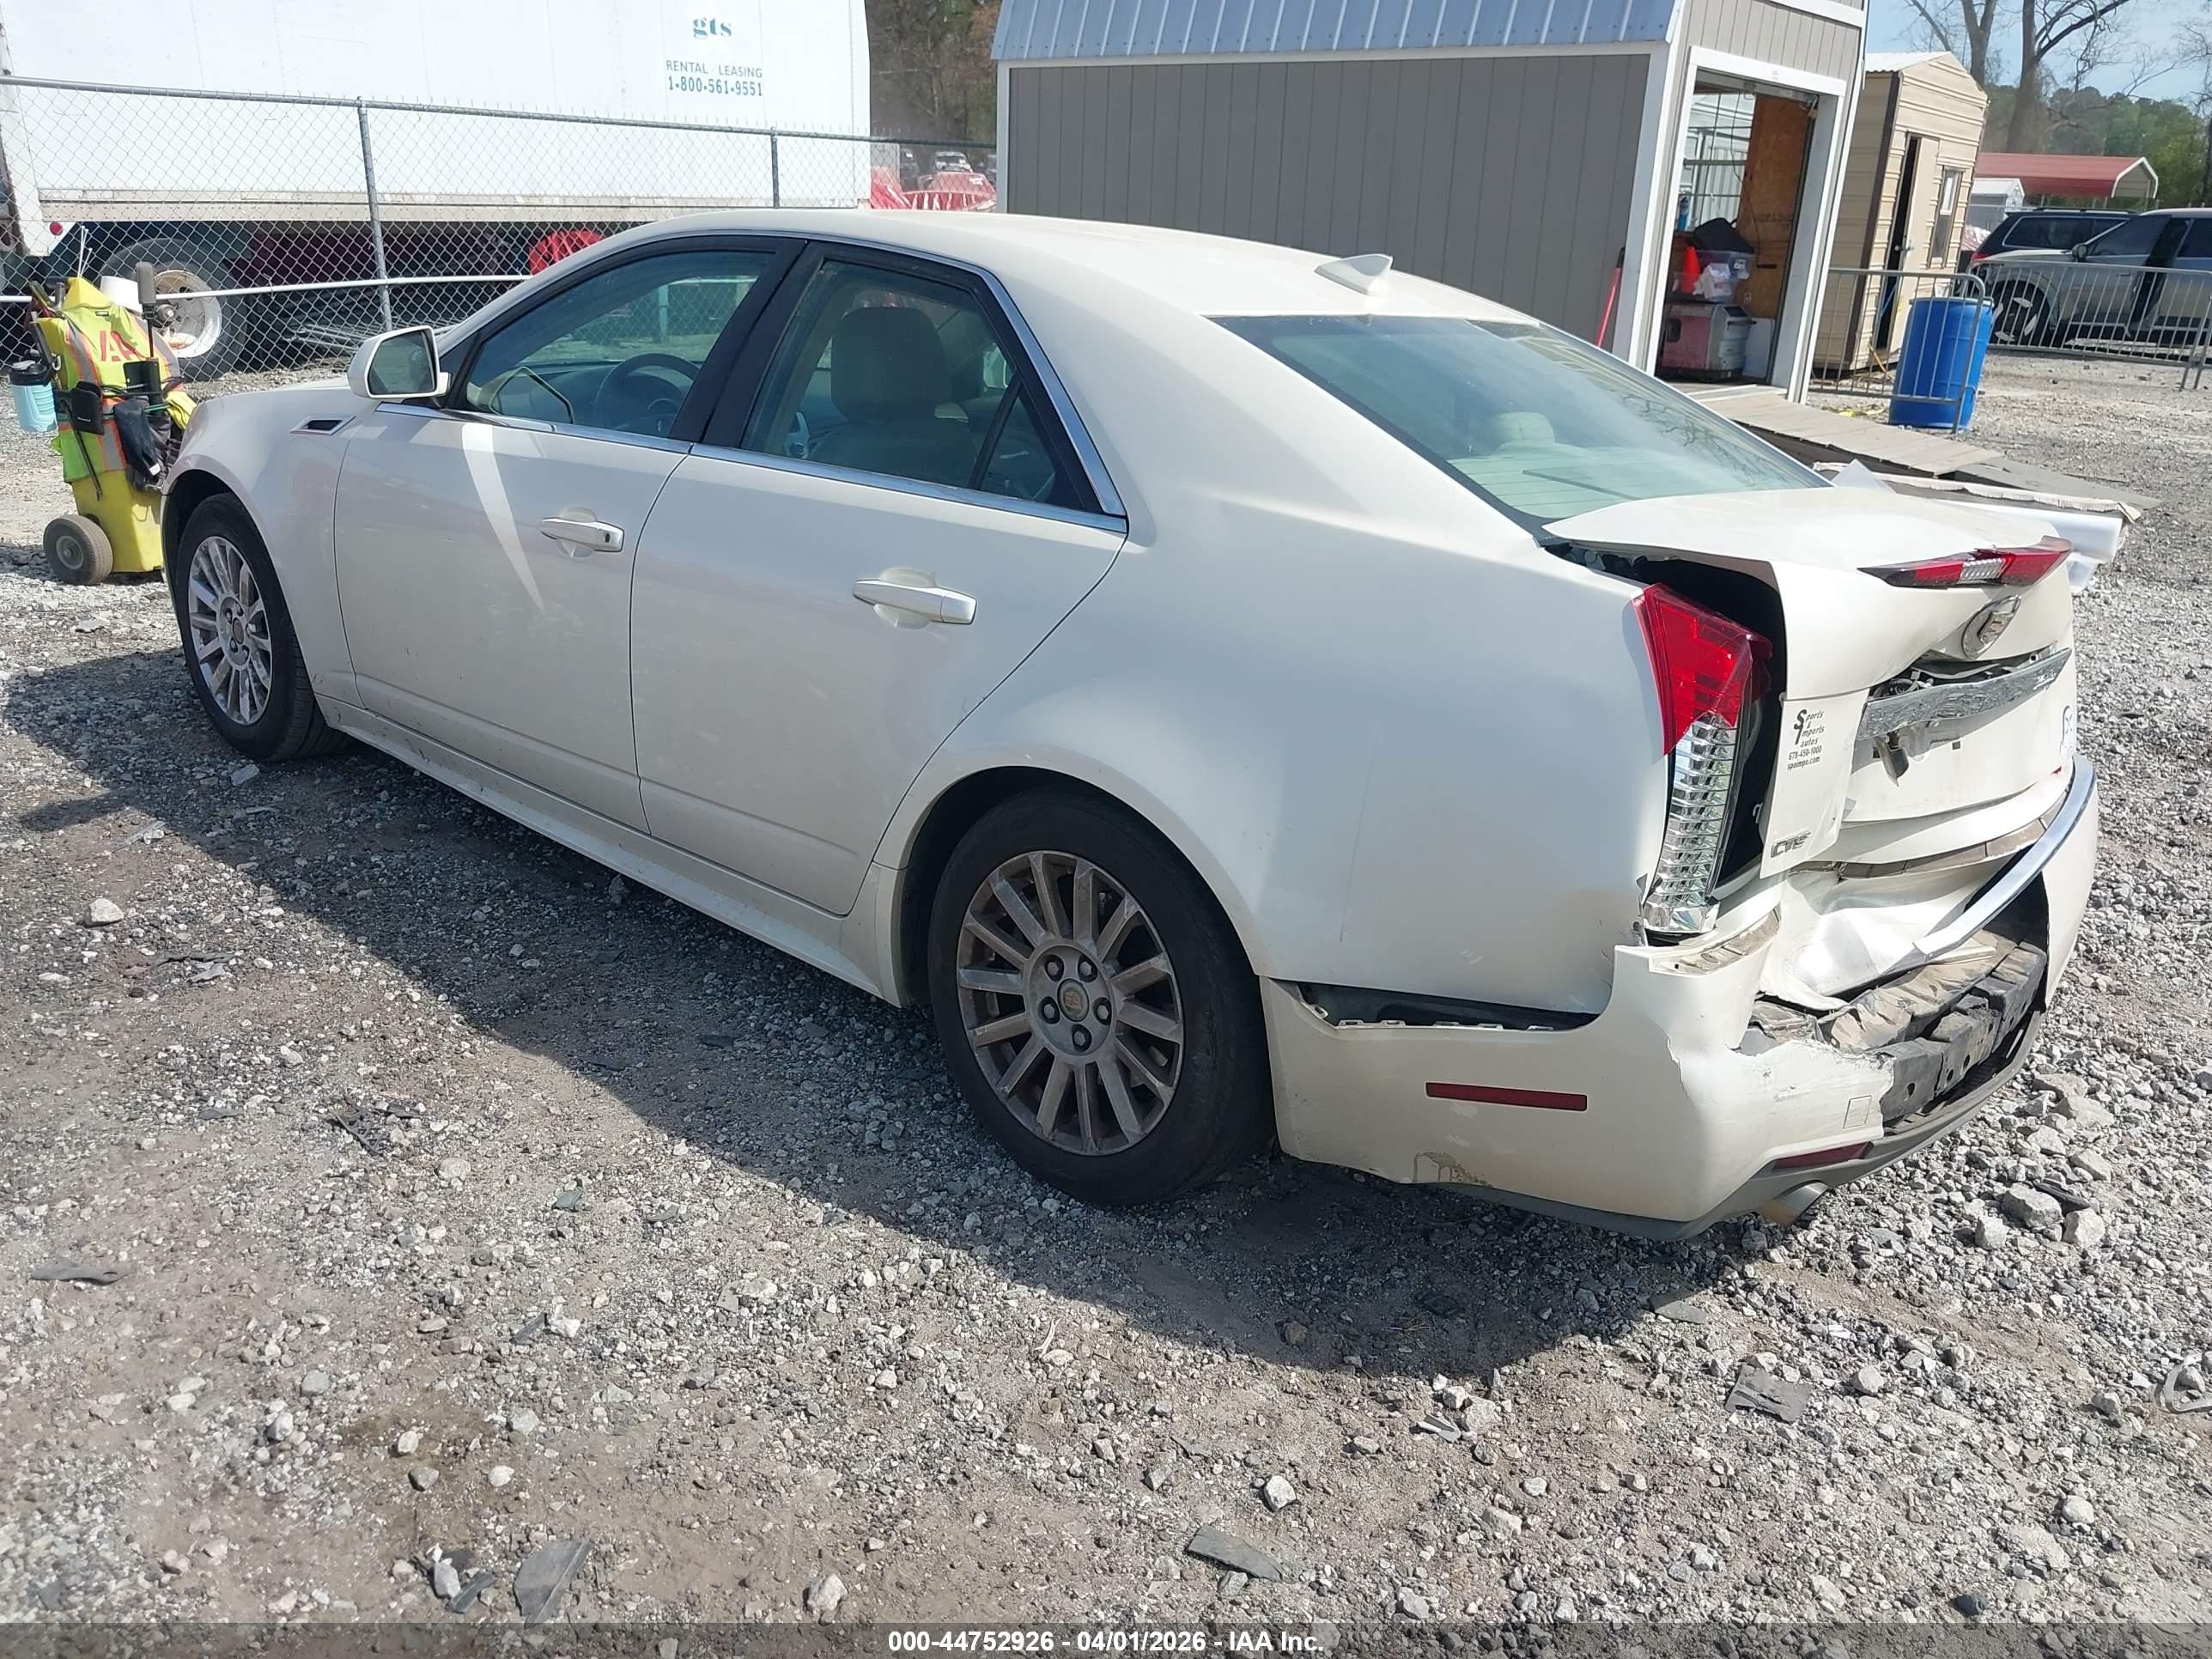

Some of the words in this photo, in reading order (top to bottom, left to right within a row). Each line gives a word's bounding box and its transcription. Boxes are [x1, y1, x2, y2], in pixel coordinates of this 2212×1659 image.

[693, 17, 732, 40] gts
[666, 59, 708, 75] RENTAL
[719, 64, 763, 78] LEASING
